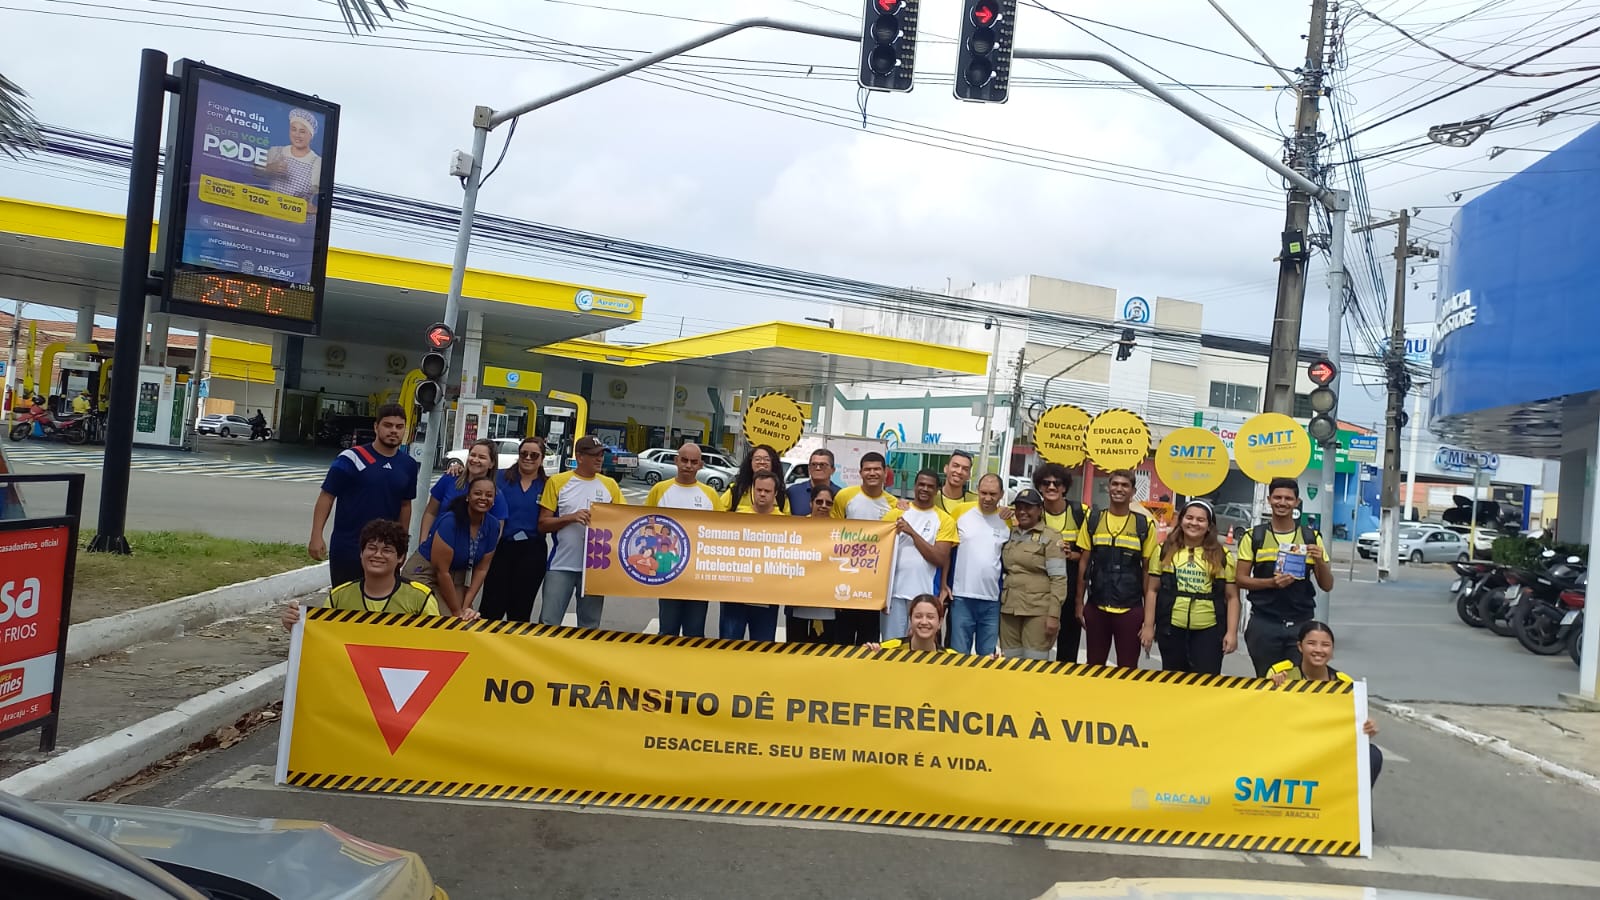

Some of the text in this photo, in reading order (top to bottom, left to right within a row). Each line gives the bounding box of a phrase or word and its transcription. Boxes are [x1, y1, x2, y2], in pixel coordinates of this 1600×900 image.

[208, 101, 265, 123] Fique em dia
[225, 114, 271, 134] Aracaju.
[203, 133, 268, 167] PODE
[212, 185, 236, 197] 100%
[248, 194, 270, 206] 120x
[279, 202, 302, 213] 16/09
[257, 265, 295, 278] ARACAJU
[755, 406, 798, 423] EDUCAÇÃO
[760, 418, 780, 429] PARA
[1043, 421, 1086, 431] EDUCAÇÃ
[1093, 427, 1141, 436] EDUCAÇÃO
[752, 426, 791, 441] TRÂNSITO
[923, 433, 942, 444] GNV
[1050, 433, 1072, 441] PARA
[1247, 430, 1294, 447] SMTT
[1169, 445, 1216, 458] SMTT
[698, 525, 740, 540] Semana
[743, 528, 788, 544] Nacional
[789, 531, 802, 545] da
[830, 526, 880, 543] #Inclua
[696, 541, 736, 556] Pessoa
[738, 547, 761, 558] com
[763, 546, 822, 562] Deficiência
[833, 543, 880, 557] nossa
[695, 557, 805, 579] Intelectual e Múltipla
[850, 555, 879, 574] voz!
[852, 591, 873, 599] APAE
[4, 622, 37, 643] FRIOS
[2, 709, 26, 723] Aracaju
[30, 704, 39, 713] SE
[484, 678, 1149, 748] NO TRÂNSITO DÊ PREFERÊNCIA À VIDA.
[644, 735, 992, 773] DESACELERE. SEU BEM MAIOR É A VIDA.
[1155, 776, 1319, 805] ARACAJU SMTT
